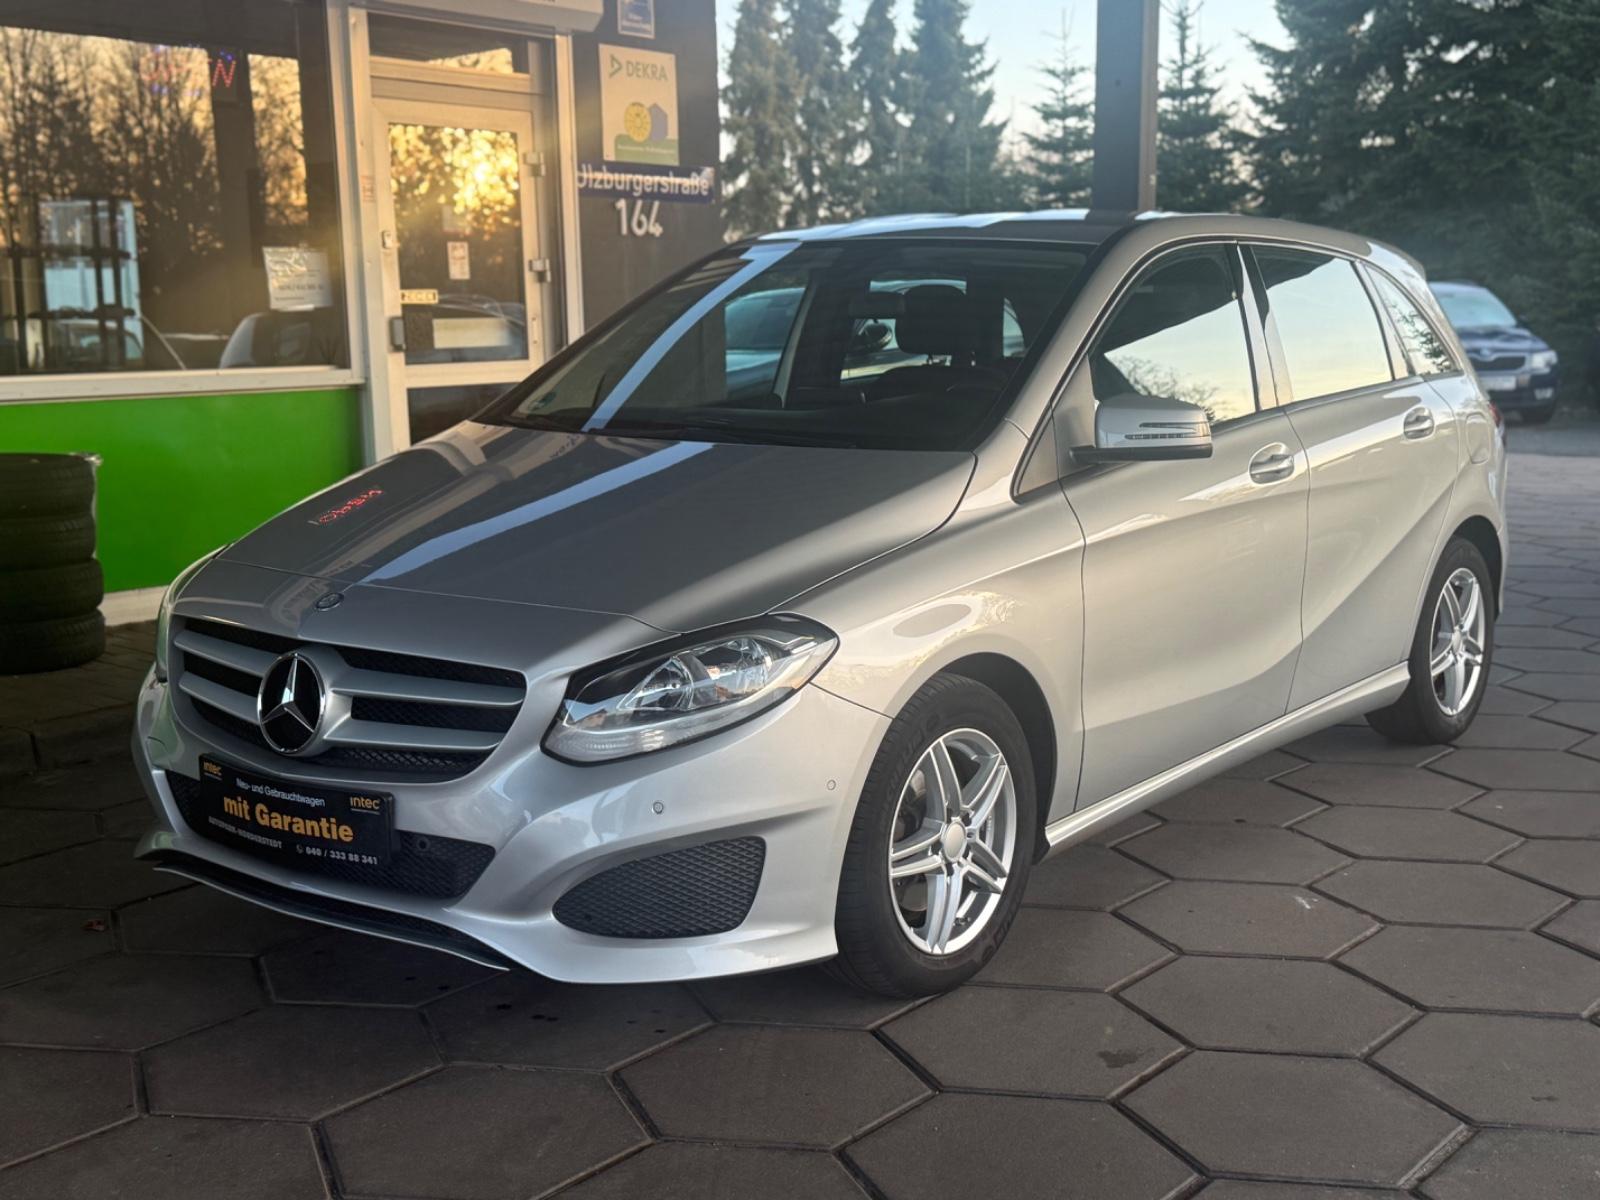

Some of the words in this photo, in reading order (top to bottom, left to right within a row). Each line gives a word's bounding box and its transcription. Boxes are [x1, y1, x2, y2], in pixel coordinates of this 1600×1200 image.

[626, 60, 669, 82] DEKRA
[615, 198, 663, 237] 164
[251, 784, 264, 794] und
[224, 795, 251, 820] mit
[255, 802, 354, 843] Garantie
[329, 850, 346, 860] 333
